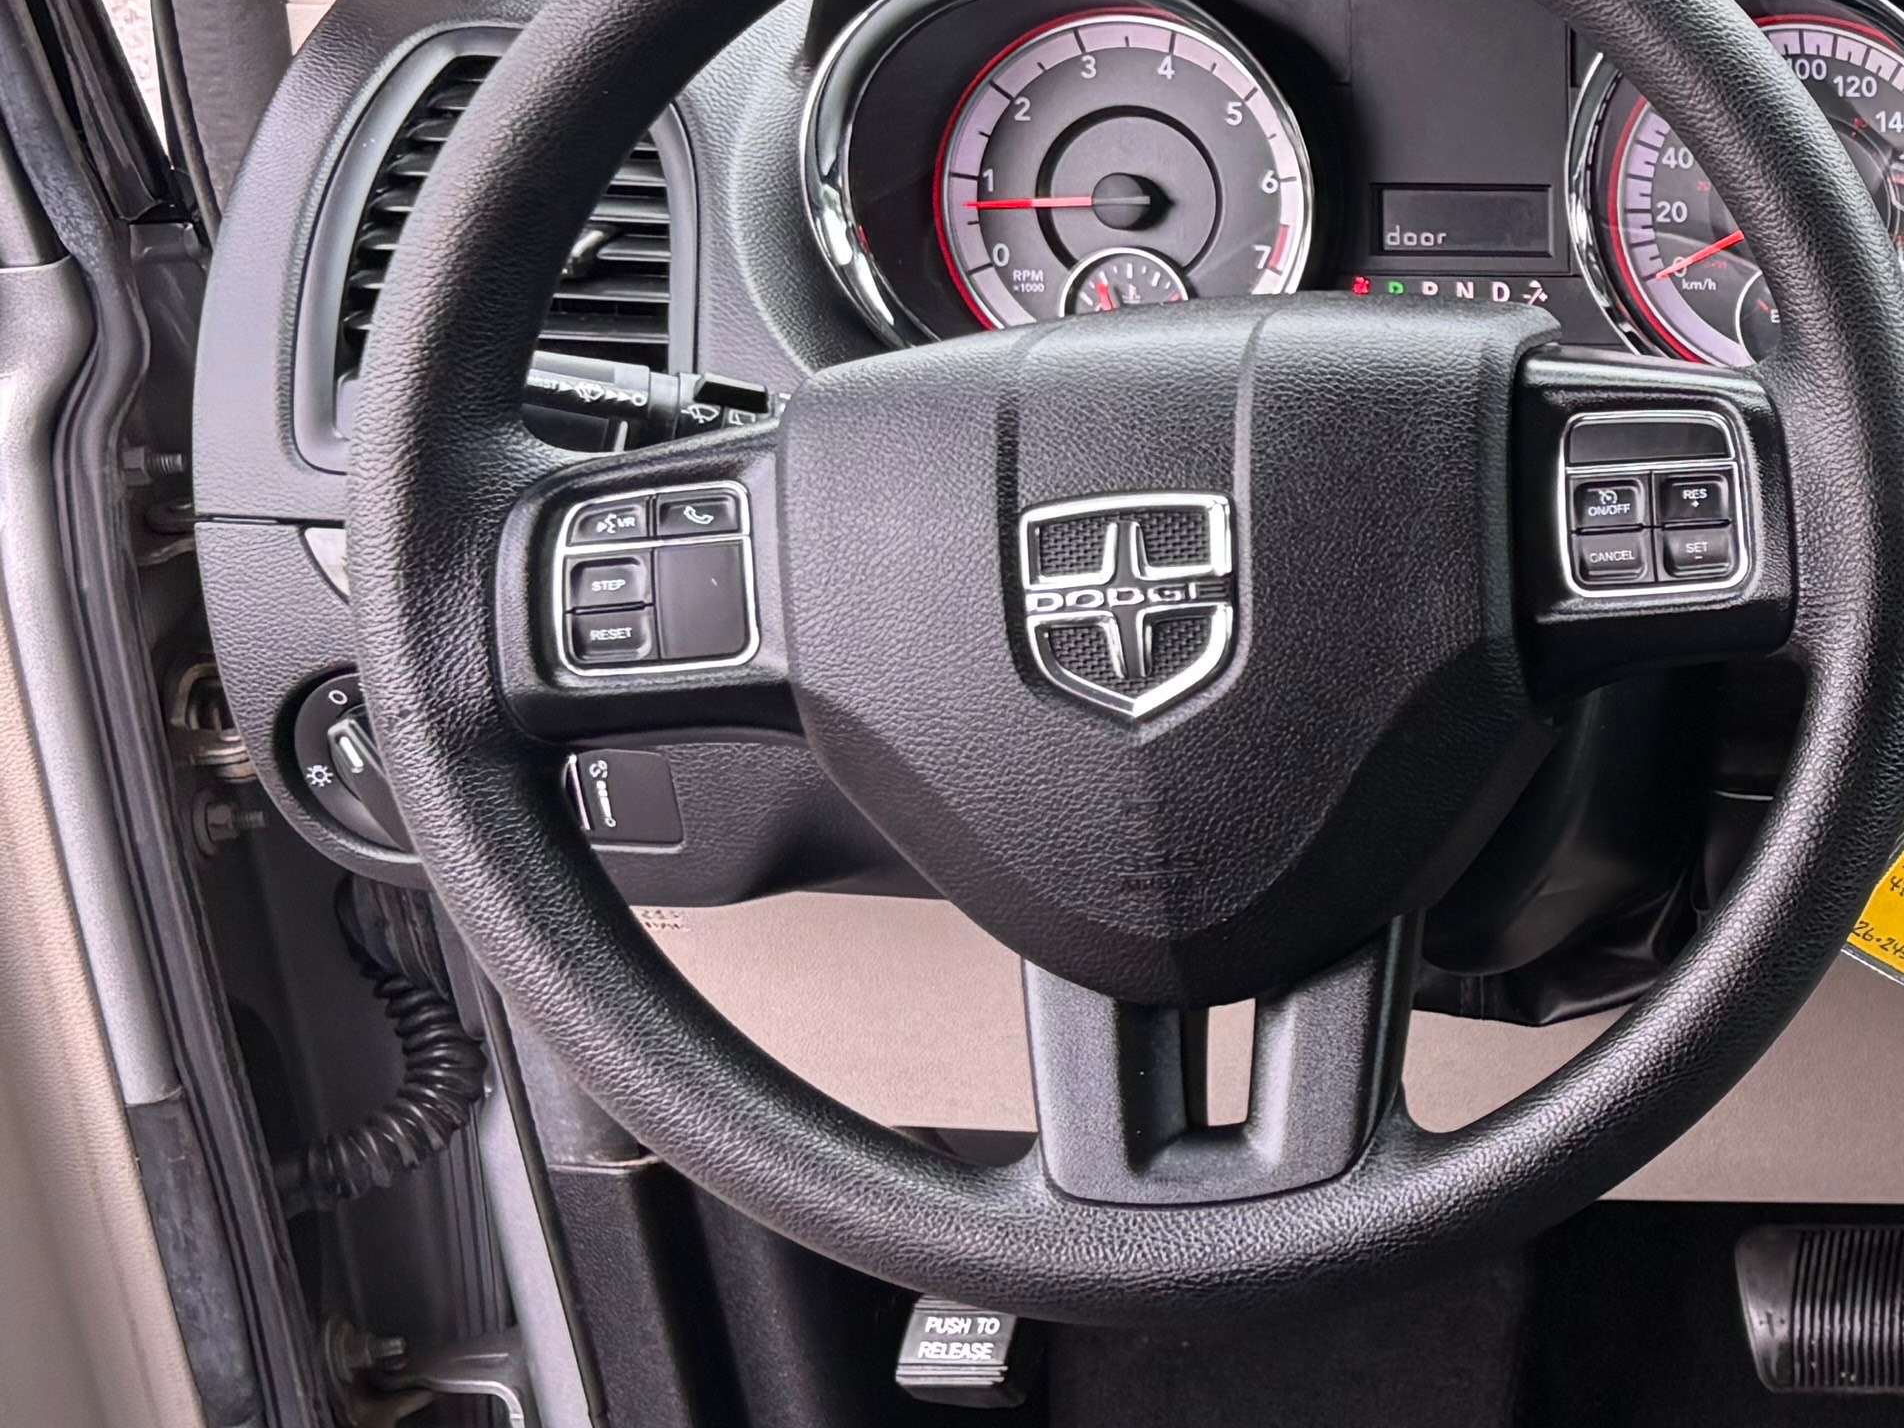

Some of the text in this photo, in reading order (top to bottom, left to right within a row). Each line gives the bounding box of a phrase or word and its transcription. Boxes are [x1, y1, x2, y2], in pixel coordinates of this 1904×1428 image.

[1081, 56, 1097, 79] 3
[1157, 56, 1175, 80] 4
[1833, 76, 1878, 98] 120
[1014, 98, 1031, 121] 2
[1224, 102, 1243, 126] 5
[1662, 147, 1694, 169] 40
[983, 169, 994, 191] 1
[1261, 171, 1278, 194] 6
[1656, 201, 1688, 222] 20
[992, 243, 1010, 266] 0
[1255, 246, 1271, 269] 7
[1013, 269, 1044, 282] RPM
[1682, 278, 1717, 291] km/h
[1456, 281, 1474, 299] N
[1492, 281, 1511, 302] D
[1682, 488, 1708, 500] RES
[1587, 503, 1631, 516] ON/OFF
[1590, 551, 1636, 564] CANCEL
[1685, 542, 1708, 554] SET
[591, 578, 626, 592] STEP
[590, 627, 632, 641] RESET
[924, 1316, 1000, 1335] PUSH TO
[917, 1341, 994, 1360] RELEASE
